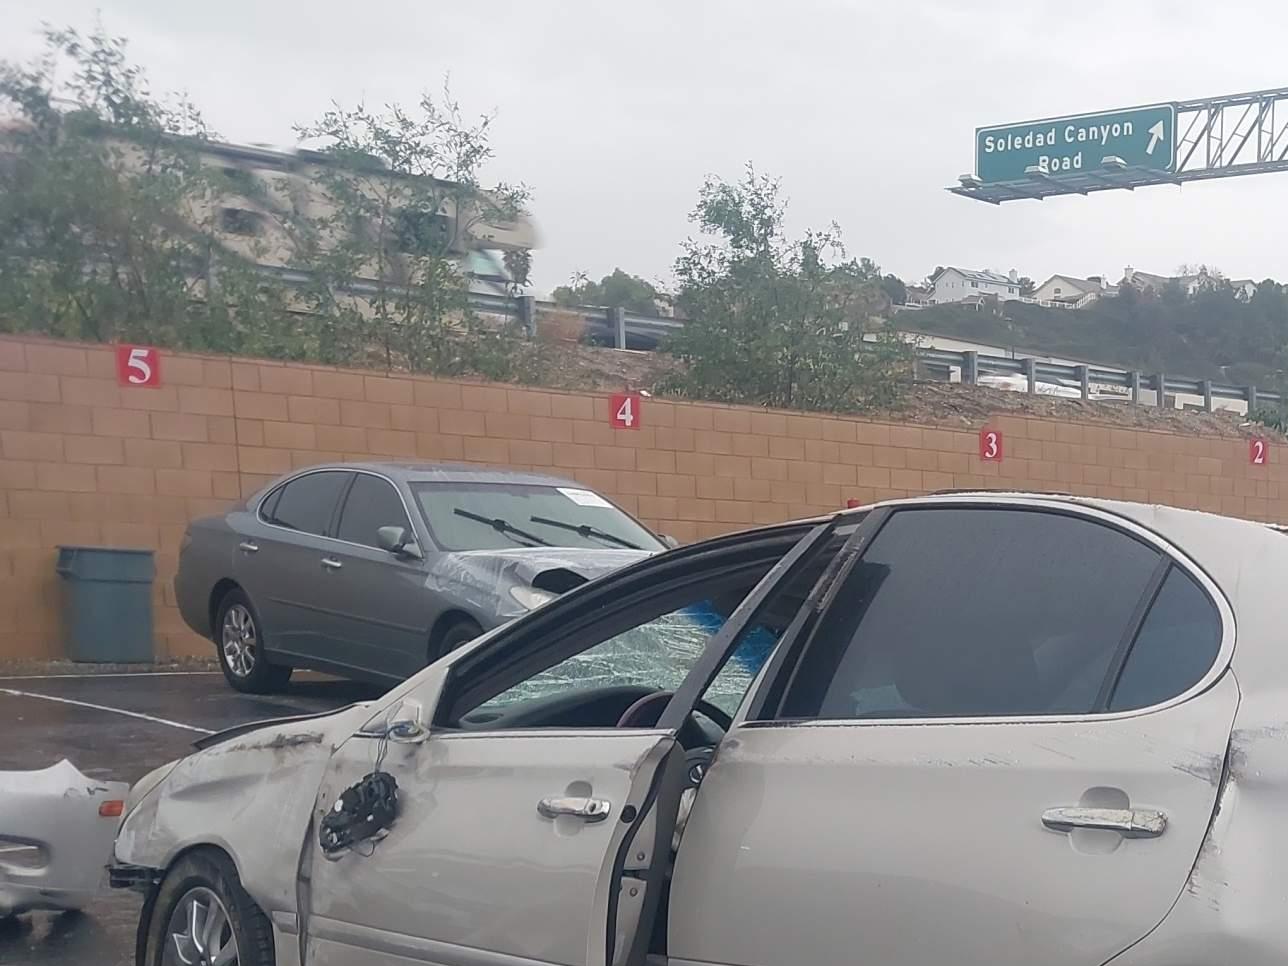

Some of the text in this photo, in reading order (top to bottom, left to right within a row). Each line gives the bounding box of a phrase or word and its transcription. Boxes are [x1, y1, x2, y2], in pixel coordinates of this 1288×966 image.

[985, 121, 1133, 153] Soledad Canyon
[1039, 151, 1082, 173] Road
[128, 349, 151, 384] 5
[616, 397, 634, 426] 4
[985, 433, 997, 458] 3
[1254, 441, 1264, 463] 2
